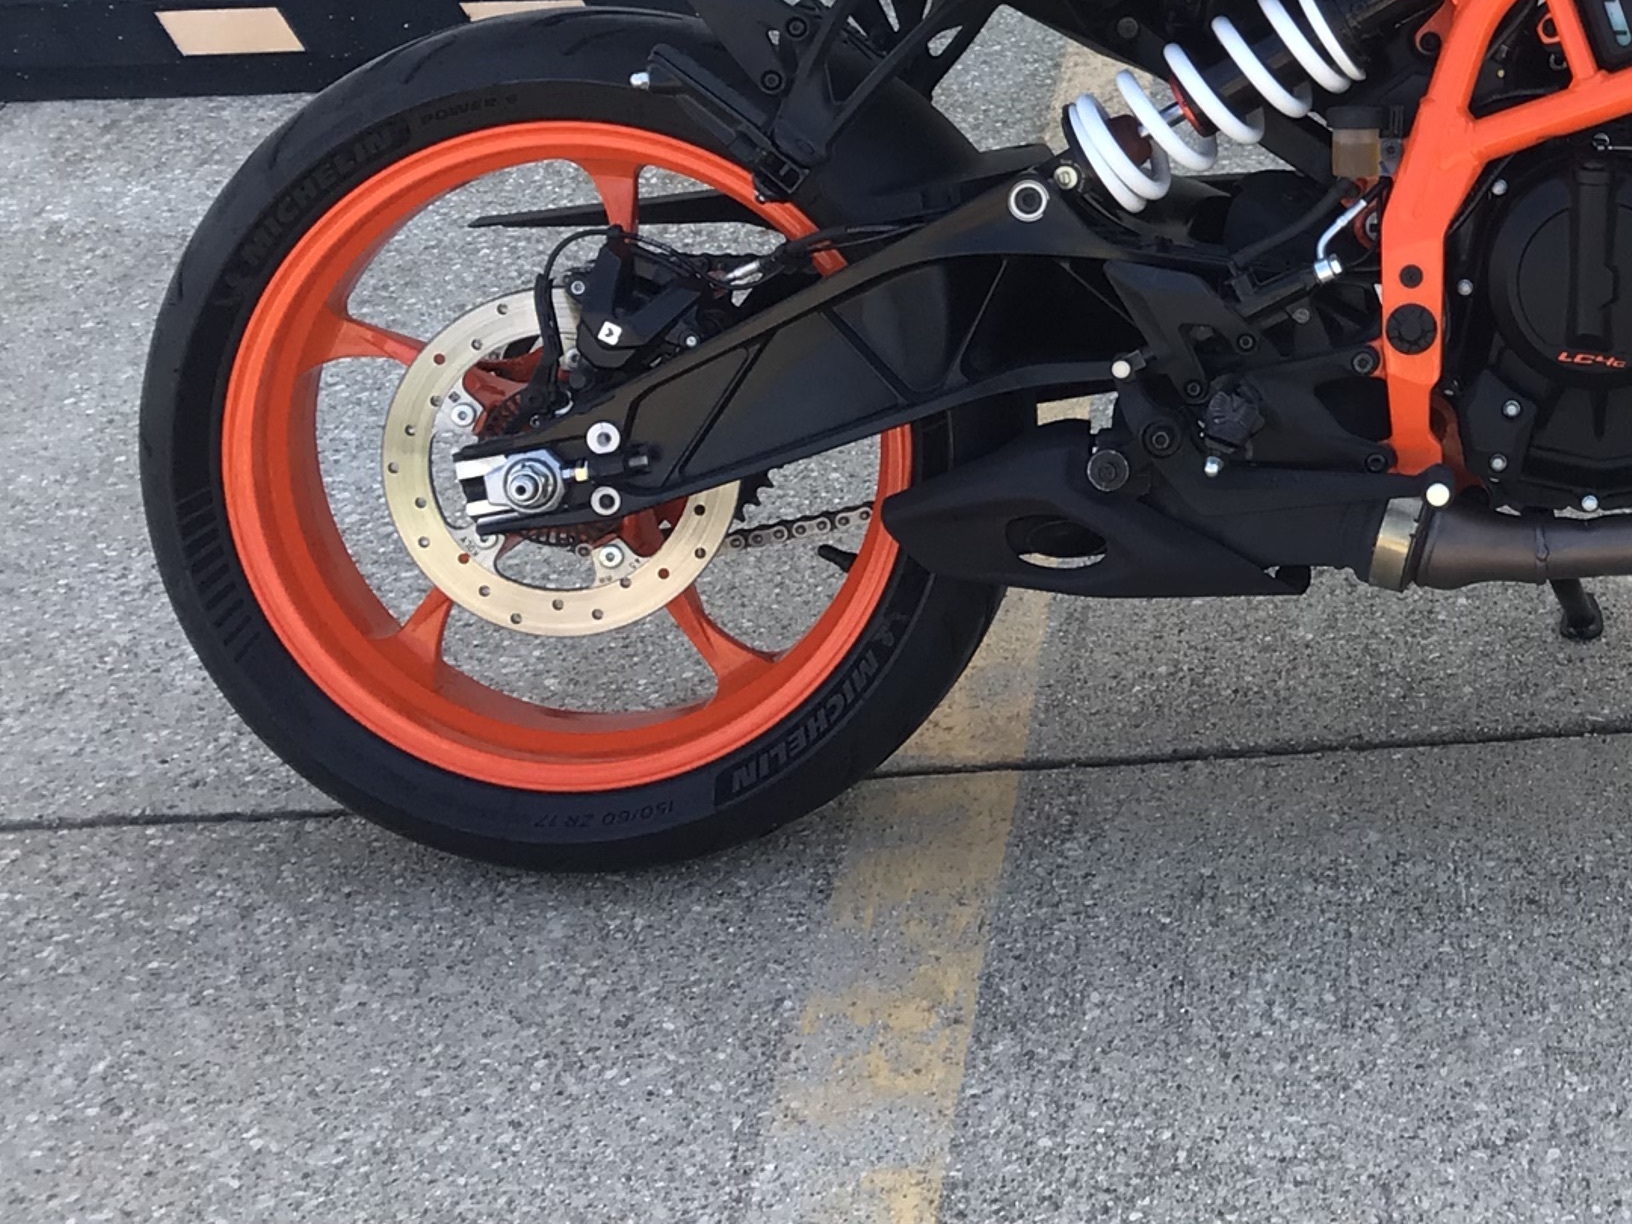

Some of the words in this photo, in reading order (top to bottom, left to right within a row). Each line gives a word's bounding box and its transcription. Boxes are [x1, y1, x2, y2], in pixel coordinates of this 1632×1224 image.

[241, 126, 398, 267] MICHELIN
[731, 648, 879, 793] MICHELIN
[602, 799, 674, 826] 150/60
